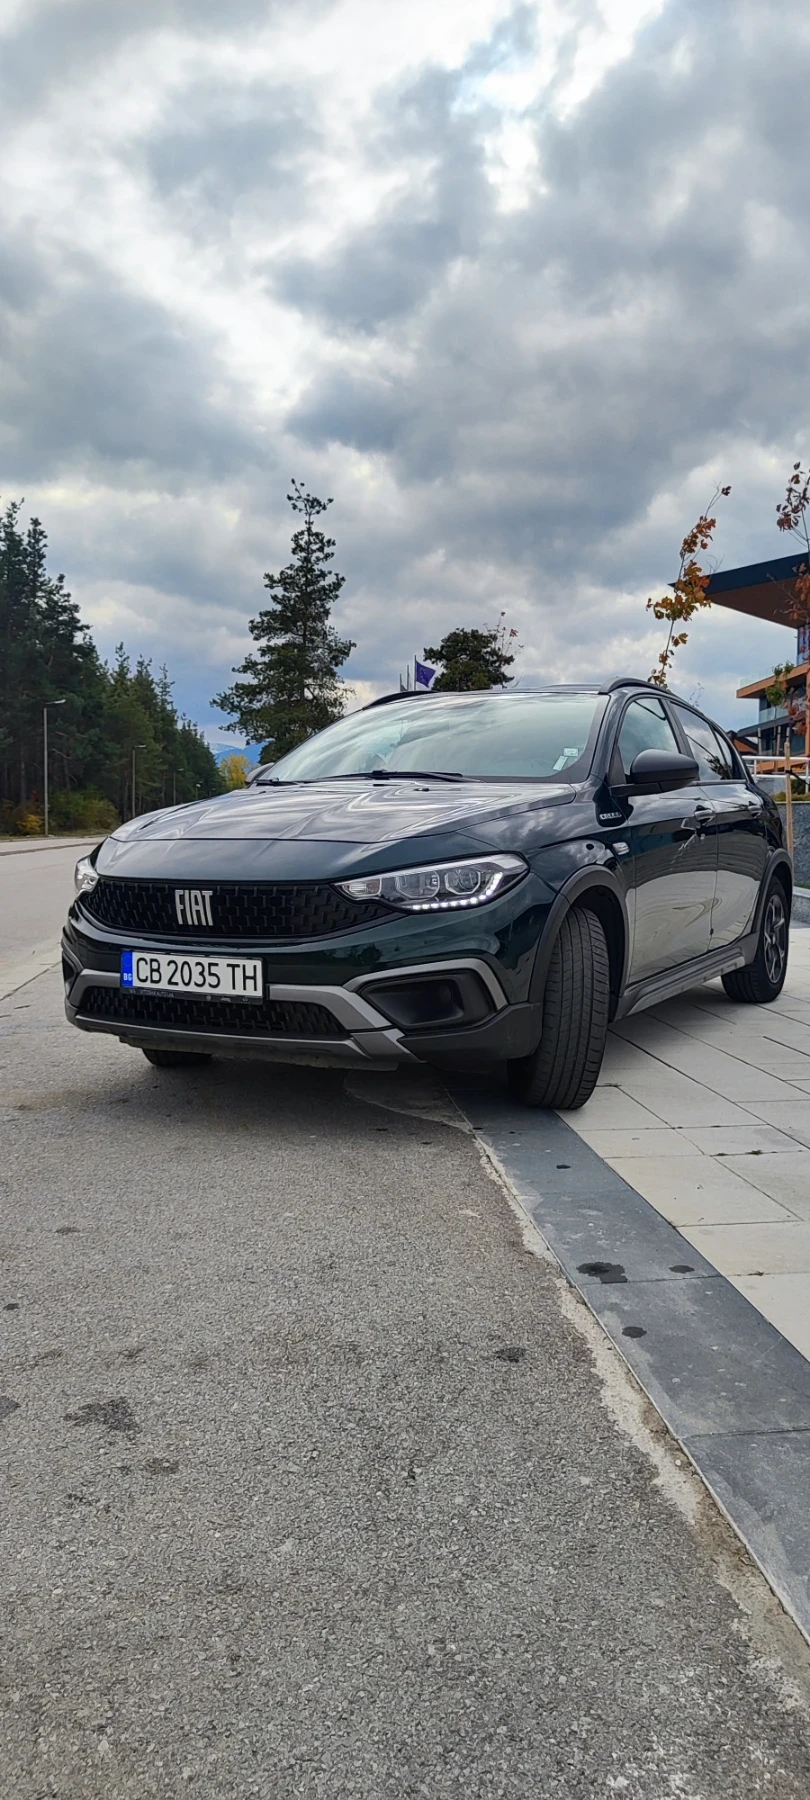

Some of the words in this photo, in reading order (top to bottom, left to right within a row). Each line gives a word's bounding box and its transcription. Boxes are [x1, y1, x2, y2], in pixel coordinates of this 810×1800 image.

[174, 889, 214, 927] FIAT
[123, 972, 133, 982] BG
[136, 957, 162, 984] CB
[166, 959, 221, 989] 2035
[226, 963, 258, 992] TH
